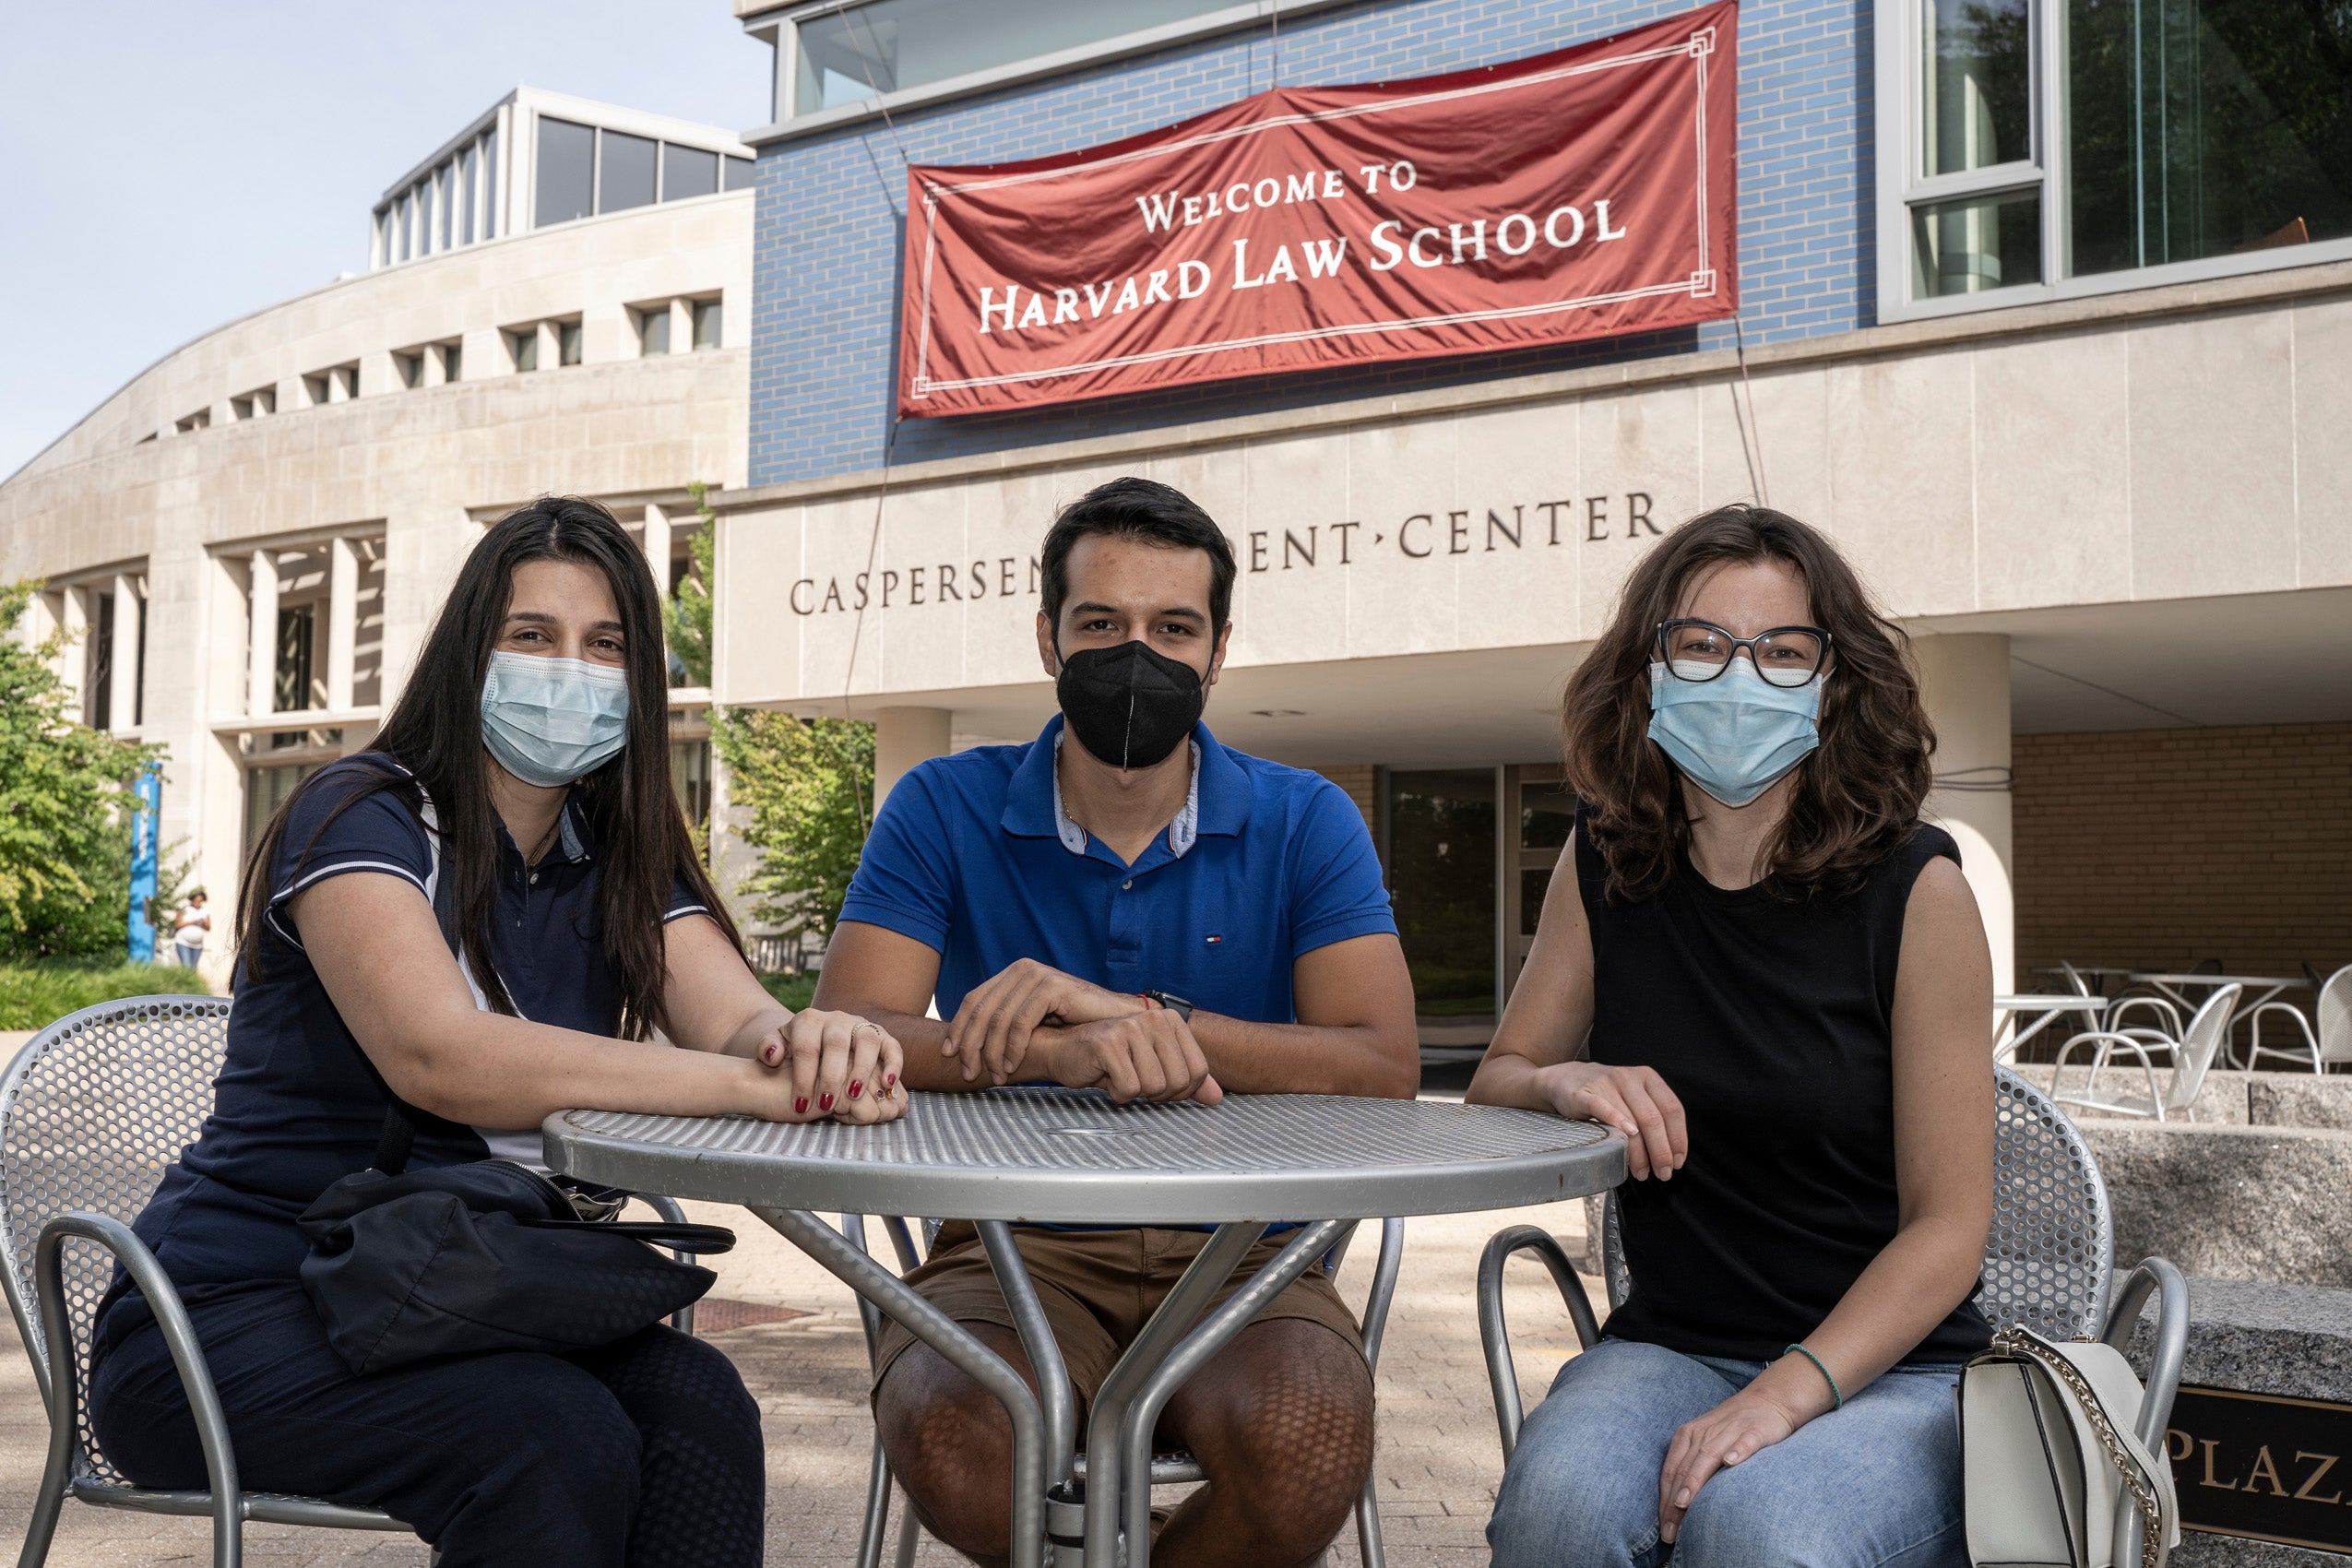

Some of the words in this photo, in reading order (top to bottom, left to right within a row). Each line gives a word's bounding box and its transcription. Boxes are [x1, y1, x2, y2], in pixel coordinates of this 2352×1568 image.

[1135, 170, 1345, 233] WELCOME
[1360, 160, 1418, 195] TO
[979, 260, 1211, 334] HARVARD
[1231, 237, 1348, 290] LAW
[1370, 198, 1627, 271] SCHOOL
[1228, 522, 1360, 573] ENT
[1398, 493, 1663, 558] CENTER
[2164, 1428, 2352, 1506] PLAZ
